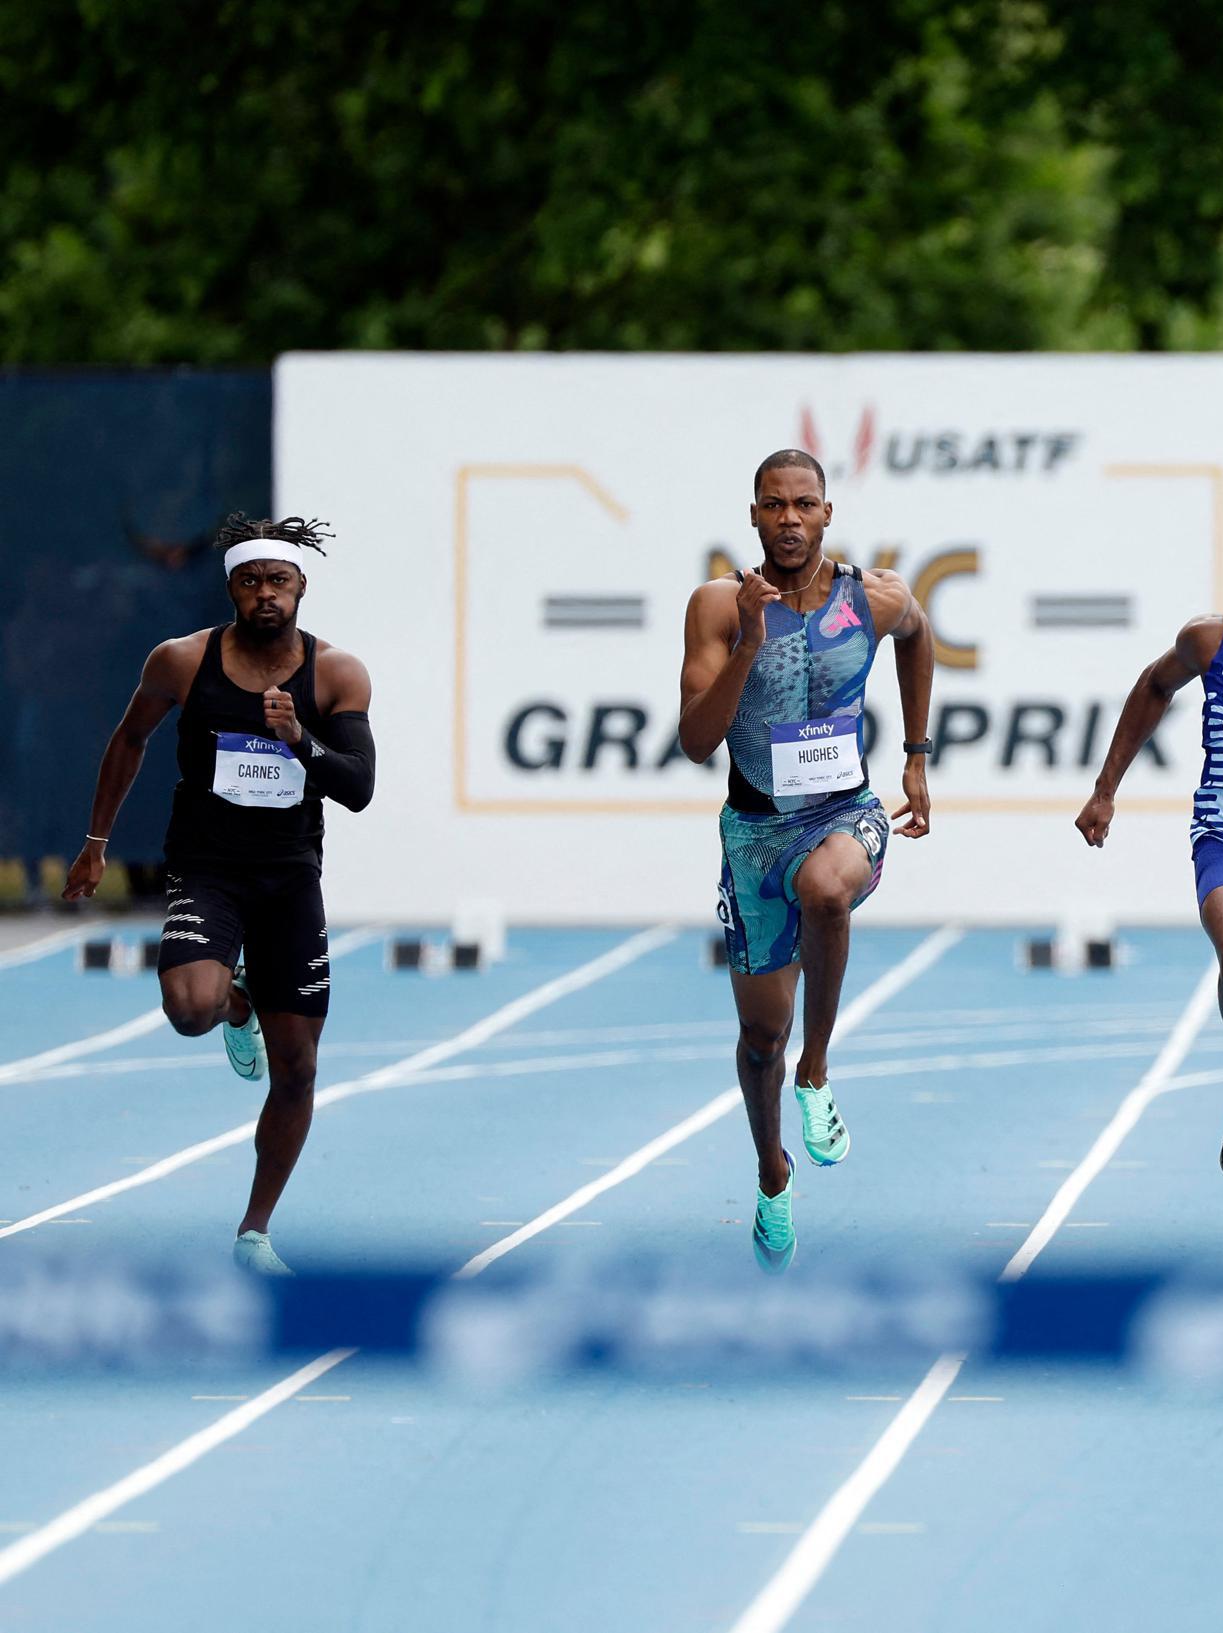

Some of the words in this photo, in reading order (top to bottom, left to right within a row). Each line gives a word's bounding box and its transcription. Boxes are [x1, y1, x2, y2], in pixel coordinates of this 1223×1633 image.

[886, 432, 1077, 471] USATF
[798, 722, 834, 739] xfinity
[245, 738, 282, 753] xfinity
[798, 746, 839, 764] HUGHES
[238, 763, 280, 780] CARNES
